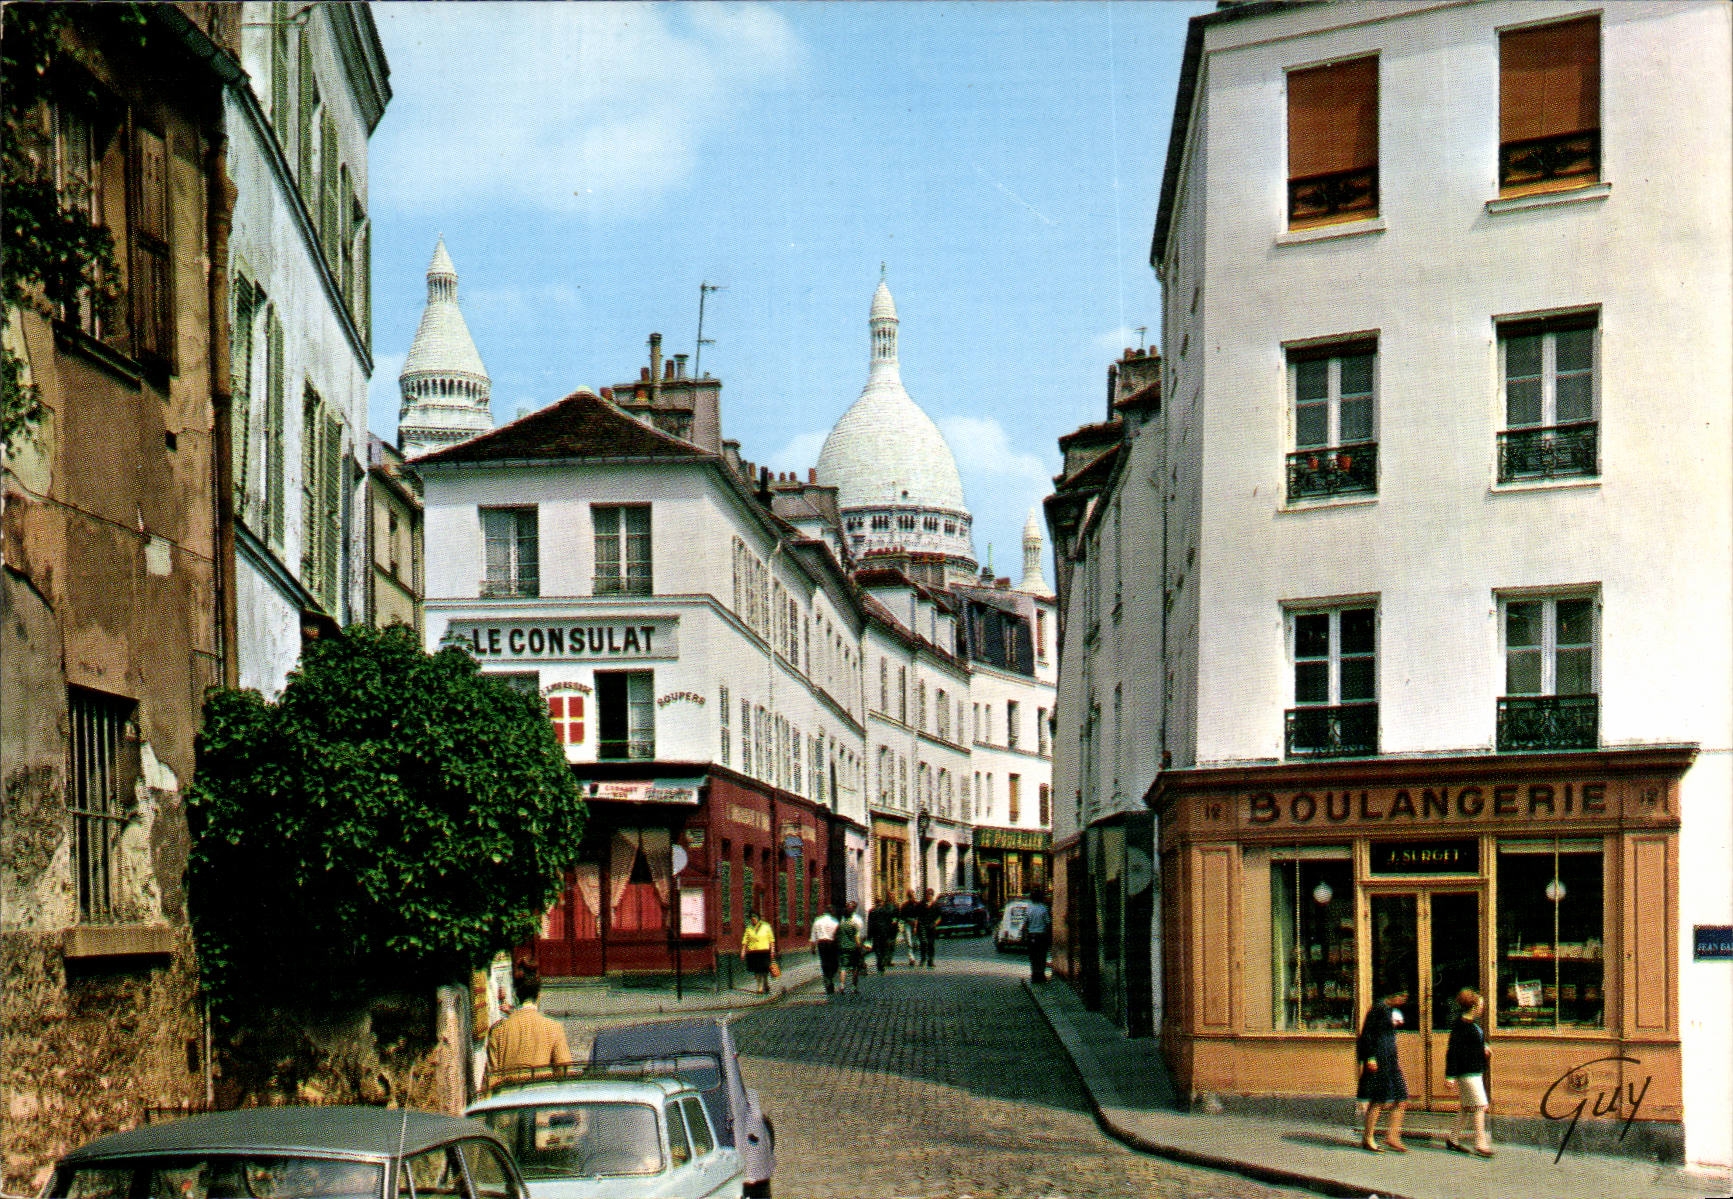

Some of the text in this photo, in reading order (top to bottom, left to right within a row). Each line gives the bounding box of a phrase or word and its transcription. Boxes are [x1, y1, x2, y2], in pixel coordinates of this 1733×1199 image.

[473, 626, 656, 655] LE CONSULAT
[656, 691, 706, 709] SOUPERS
[1248, 782, 1607, 824] BOULANGERIE
